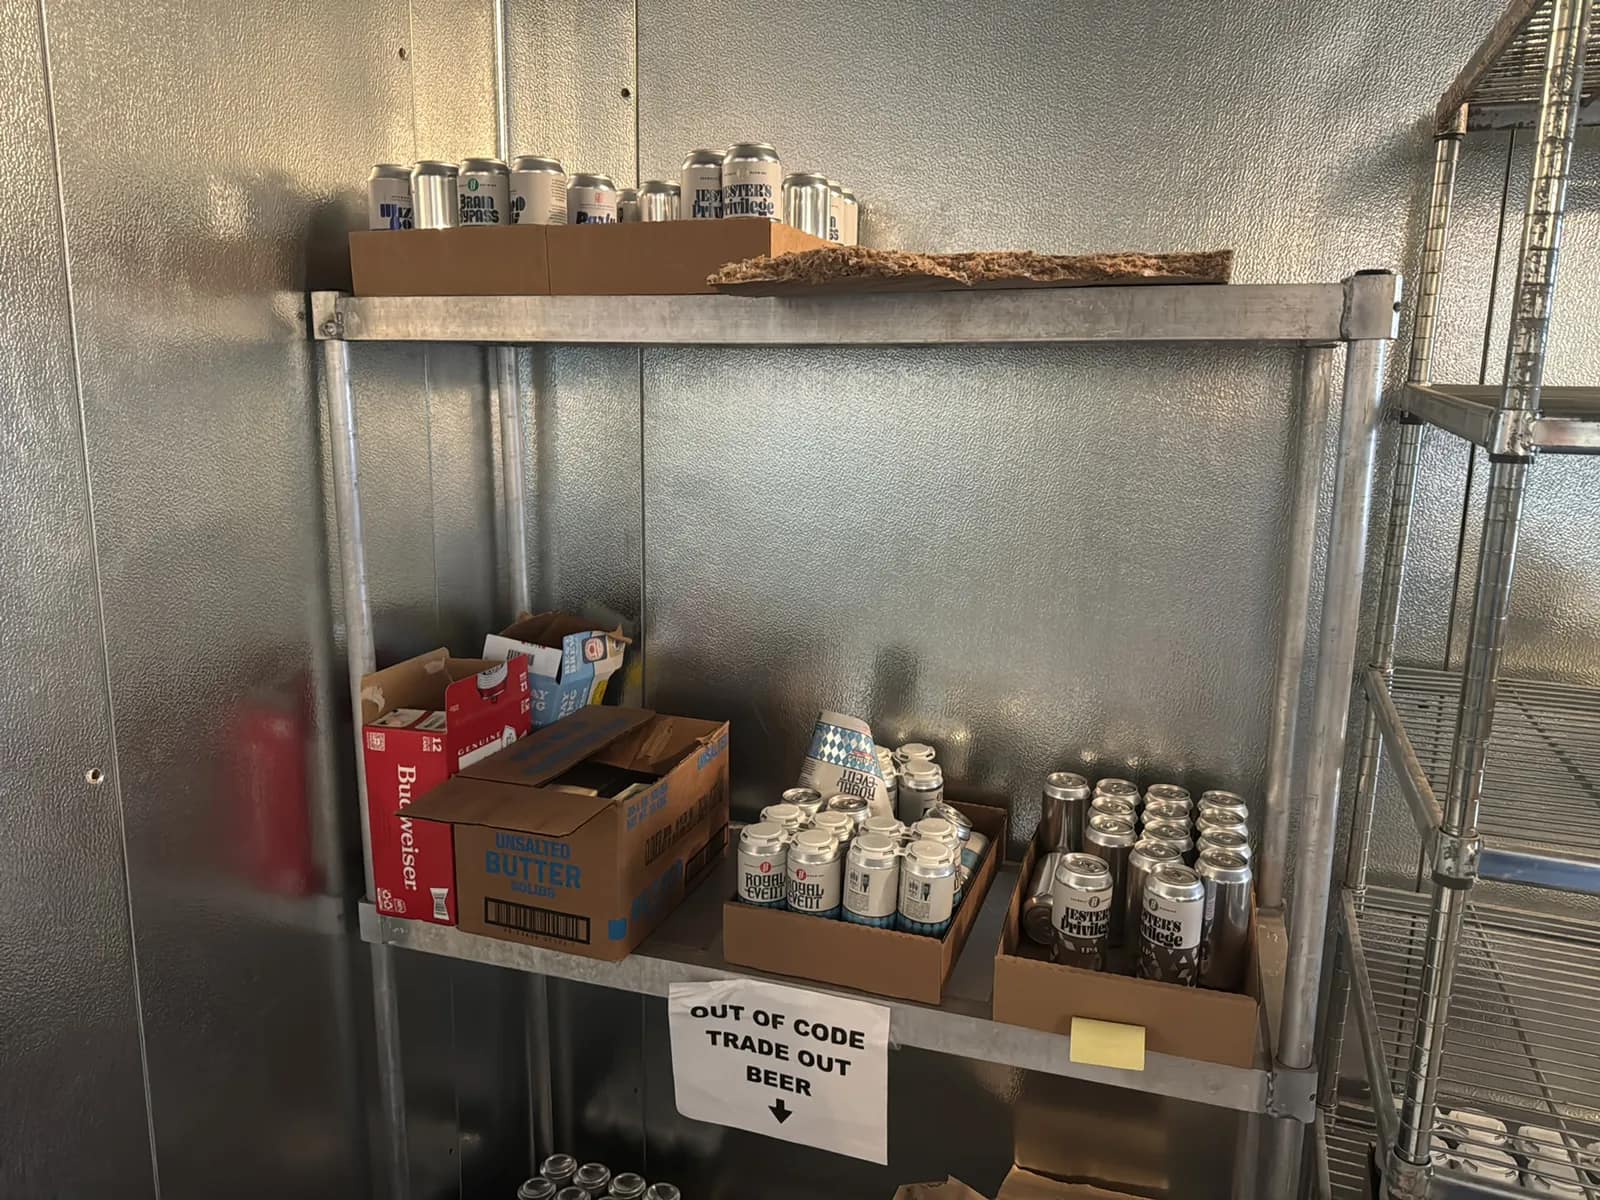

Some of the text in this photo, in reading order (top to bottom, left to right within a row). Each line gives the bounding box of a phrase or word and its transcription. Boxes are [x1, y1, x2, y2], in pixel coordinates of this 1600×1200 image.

[432, 737, 442, 753] 12
[496, 832, 572, 860] UNSALTED
[485, 851, 582, 889] BUTTER
[745, 873, 786, 887] ROYAL
[744, 886, 785, 900] EVENT
[690, 1004, 865, 1050] OUT OF CODE
[705, 1030, 852, 1077] TRADE OUT
[746, 1065, 812, 1097] BEER
